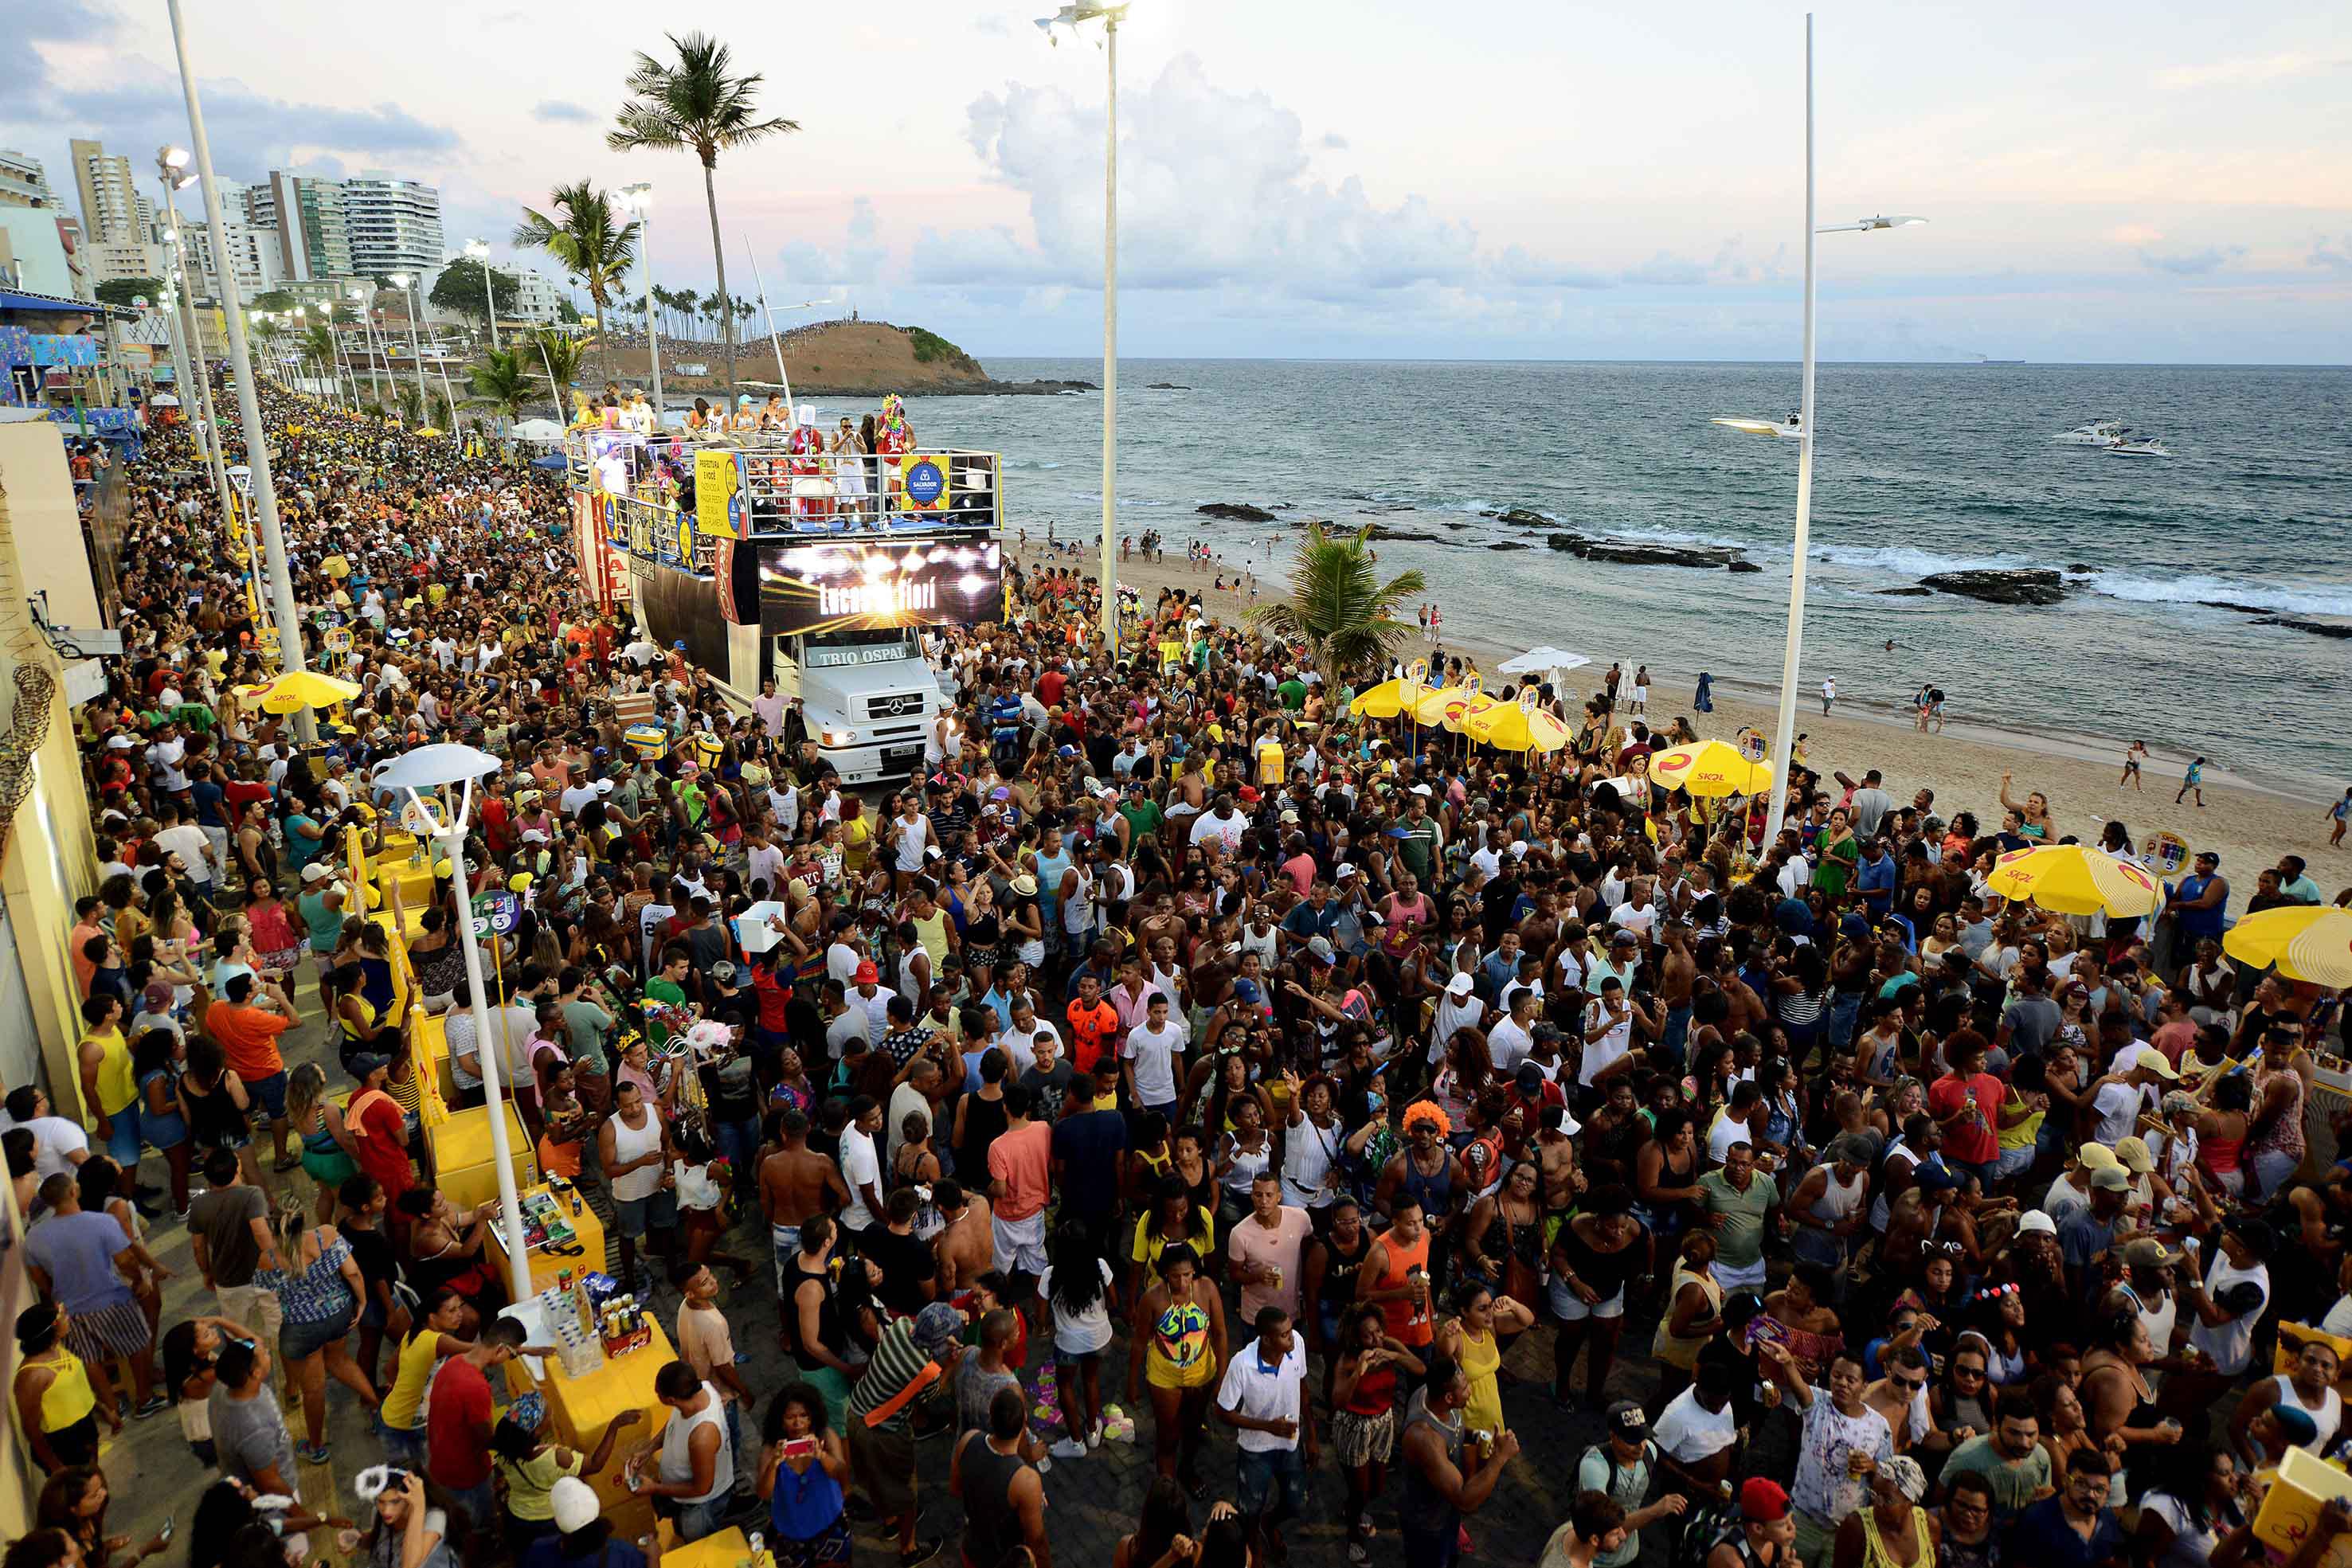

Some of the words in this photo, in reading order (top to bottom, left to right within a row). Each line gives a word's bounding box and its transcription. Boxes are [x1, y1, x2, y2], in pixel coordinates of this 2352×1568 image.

[819, 651, 858, 666] TRIO
[862, 647, 906, 663] OSPAL
[1696, 772, 1725, 781] SKOL
[2005, 869, 2034, 883] SKOL
